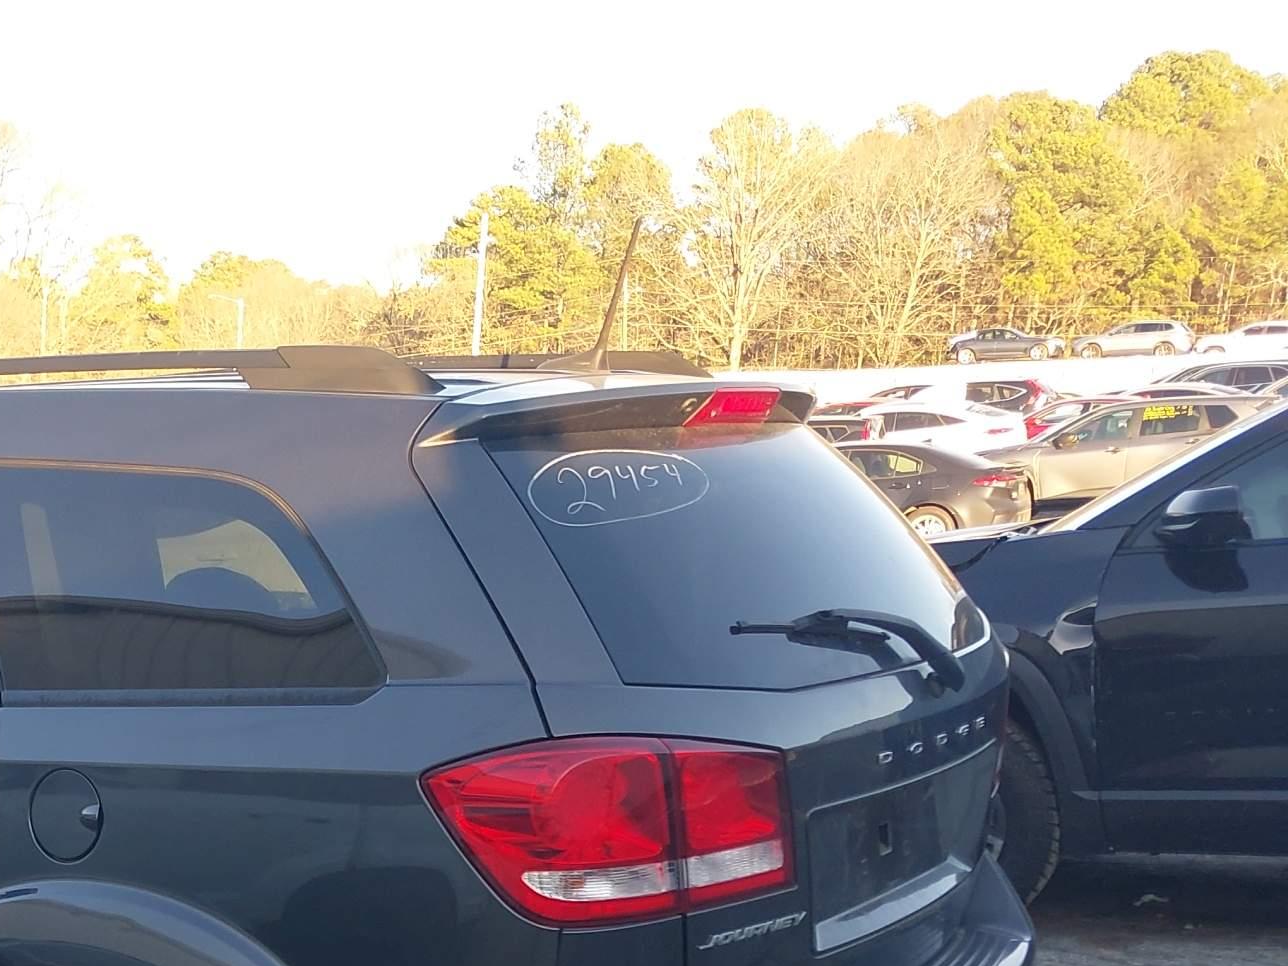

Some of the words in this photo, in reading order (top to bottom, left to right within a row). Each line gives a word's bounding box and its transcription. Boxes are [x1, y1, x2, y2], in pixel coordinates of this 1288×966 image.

[557, 466, 683, 514] 29454
[878, 716, 985, 764] DODGE
[697, 911, 807, 950] JOURNEY
